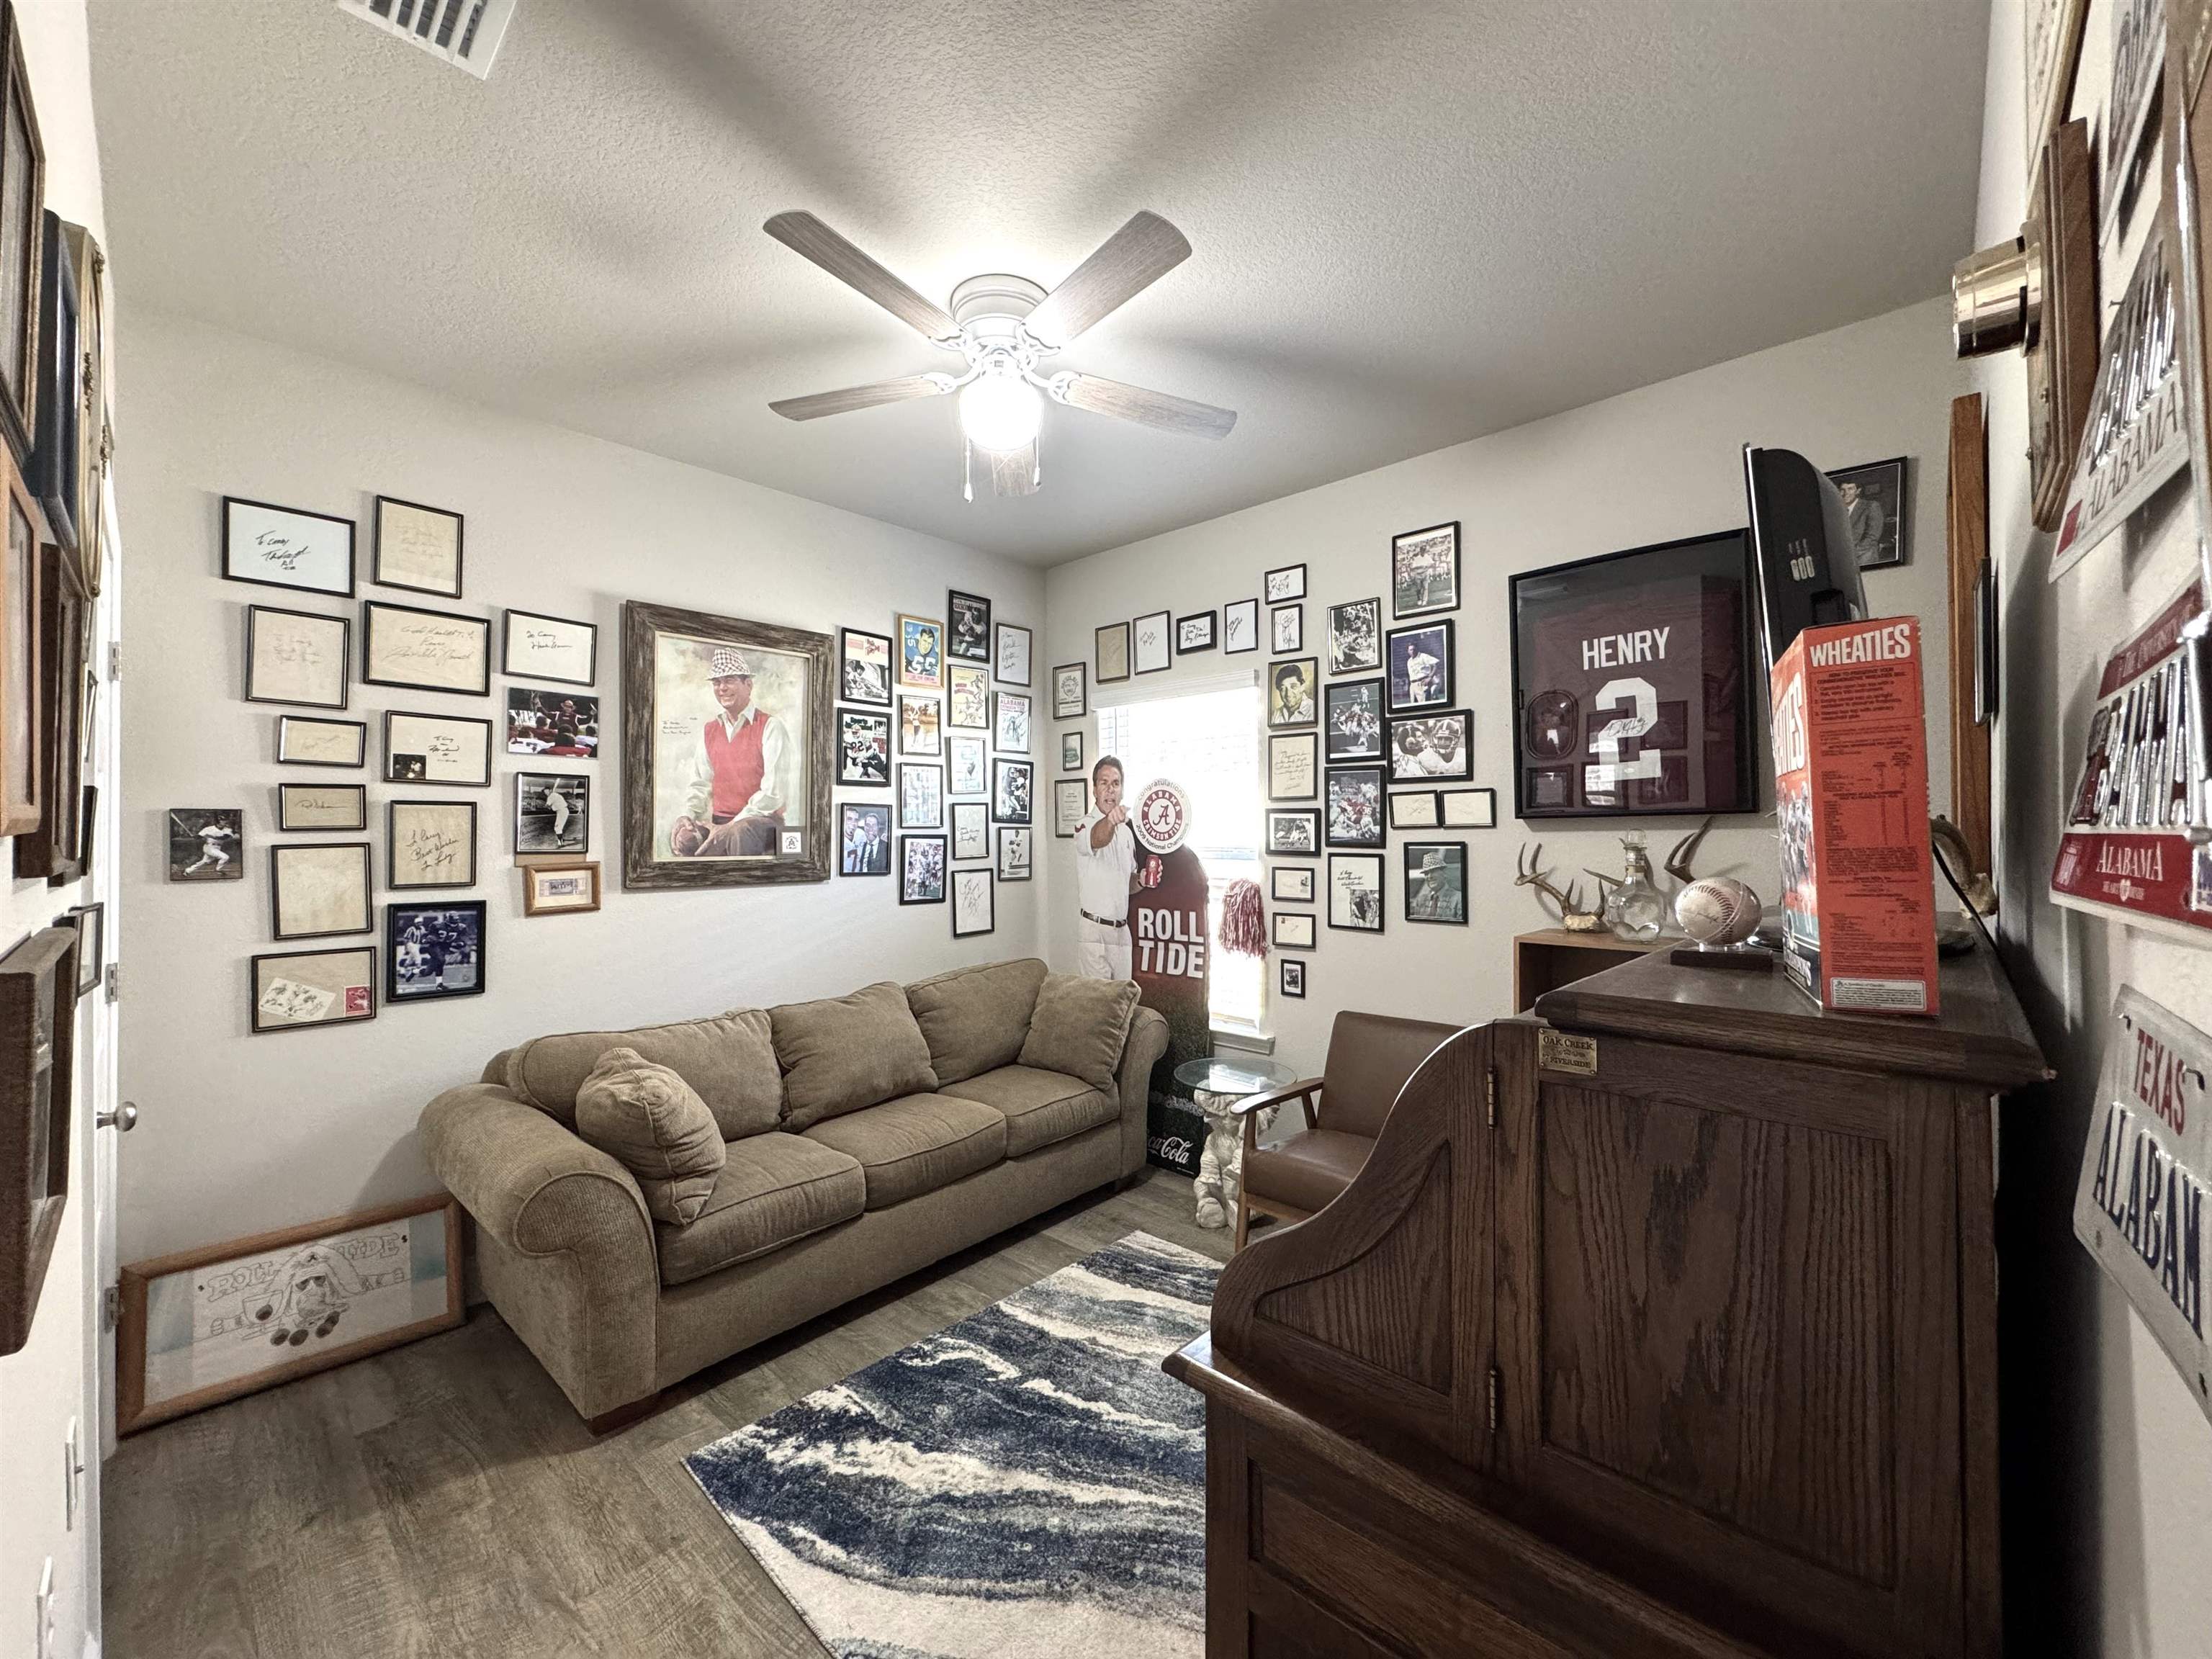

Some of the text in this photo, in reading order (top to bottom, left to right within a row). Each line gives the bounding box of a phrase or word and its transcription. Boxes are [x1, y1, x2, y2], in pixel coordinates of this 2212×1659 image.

[1583, 626, 1670, 670] HENRY
[1809, 624, 1912, 667] WHEATIES
[1595, 677, 1662, 782] 2
[1773, 671, 1805, 778] ATIES
[1143, 791, 1181, 812] ALABAMA
[1153, 804, 1170, 826] A
[1143, 819, 1182, 840] CRIMSON TIDE
[1145, 836, 1166, 850] National
[2095, 839, 2163, 882] ALABAMA
[1138, 908, 1205, 943] ROLL
[1138, 939, 1205, 979] TIDE
[1543, 1035, 1595, 1051] OAK CREEK
[1550, 1056, 1591, 1069] RIVERSIDE
[2134, 1028, 2185, 1136] TEXAS
[2093, 1102, 2204, 1341] ALABAM
